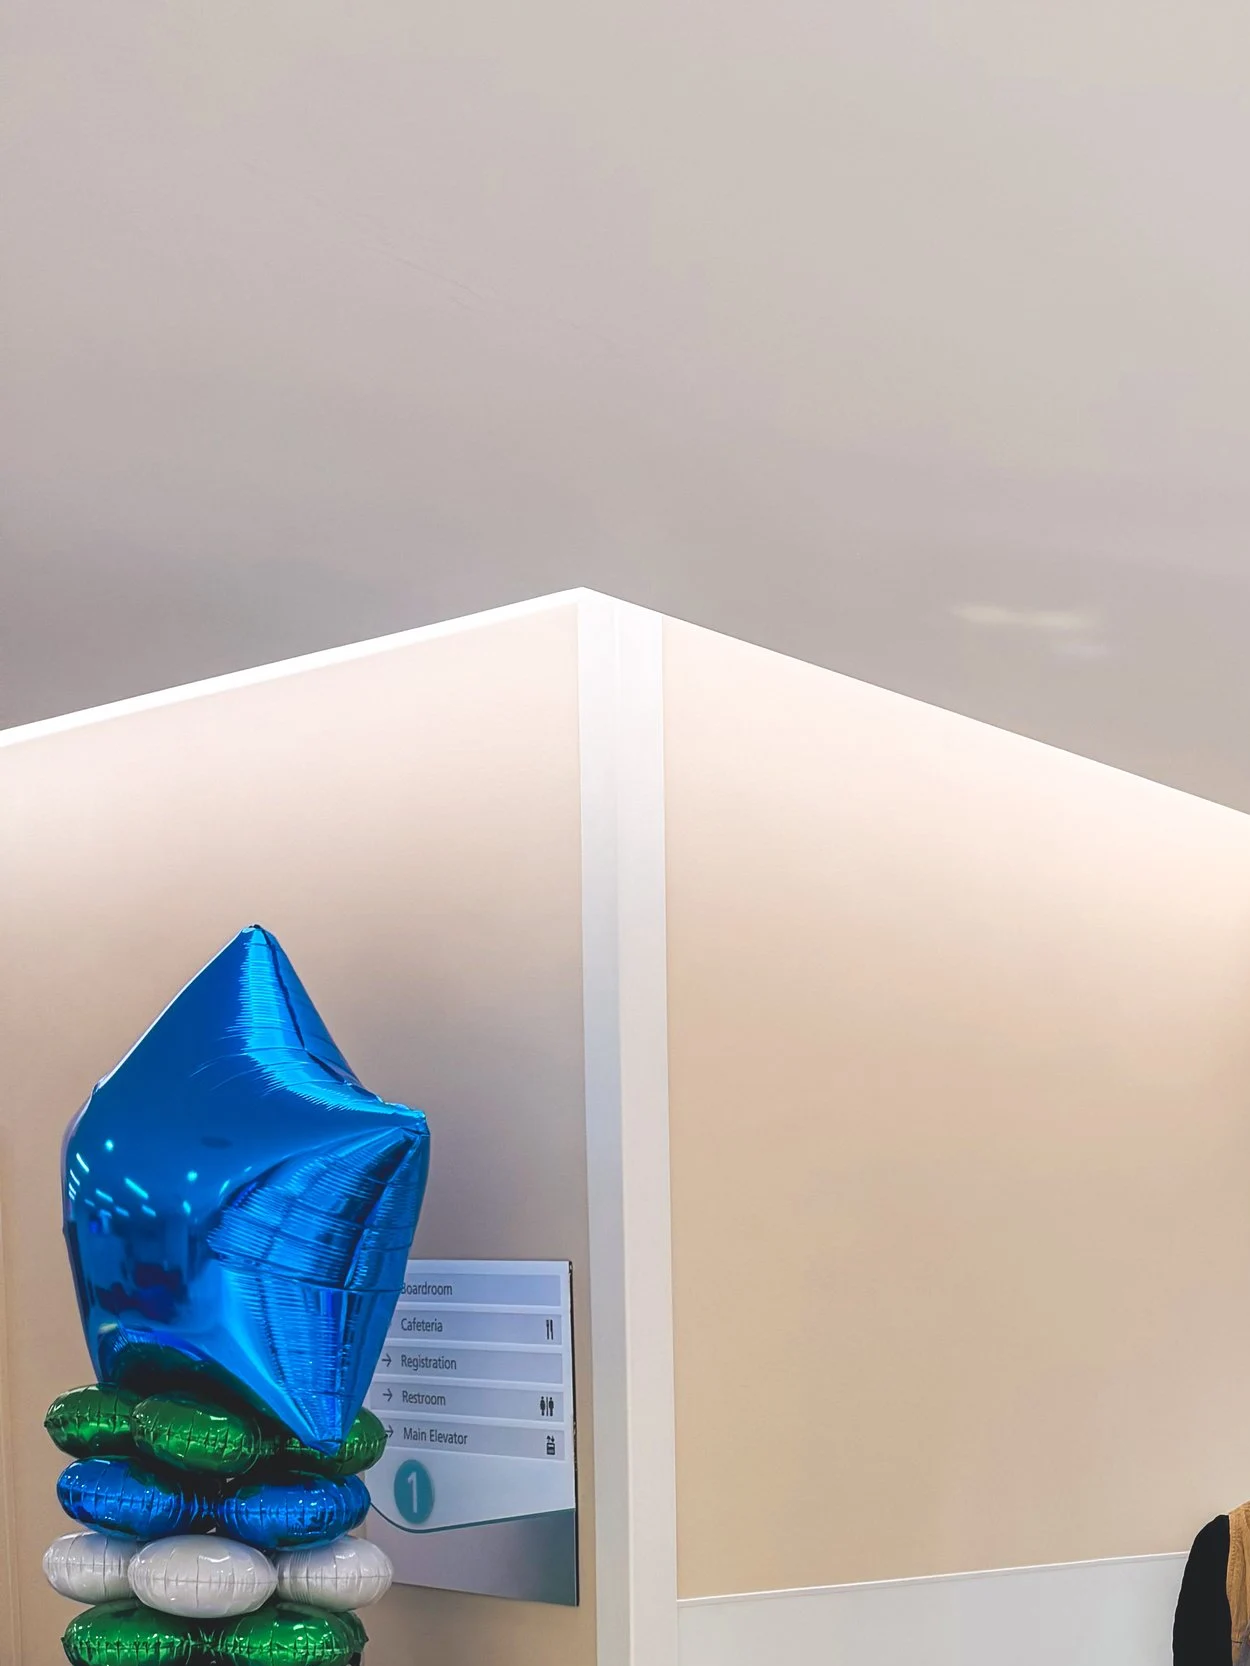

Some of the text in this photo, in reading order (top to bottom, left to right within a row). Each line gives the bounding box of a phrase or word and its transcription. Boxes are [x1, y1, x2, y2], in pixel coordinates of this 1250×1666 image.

[400, 1317, 443, 1333] Cafeteria
[400, 1354, 457, 1371] Registration
[402, 1390, 446, 1406] Restroom
[403, 1427, 468, 1445] Main Elevator
[406, 1471, 419, 1513] 1
